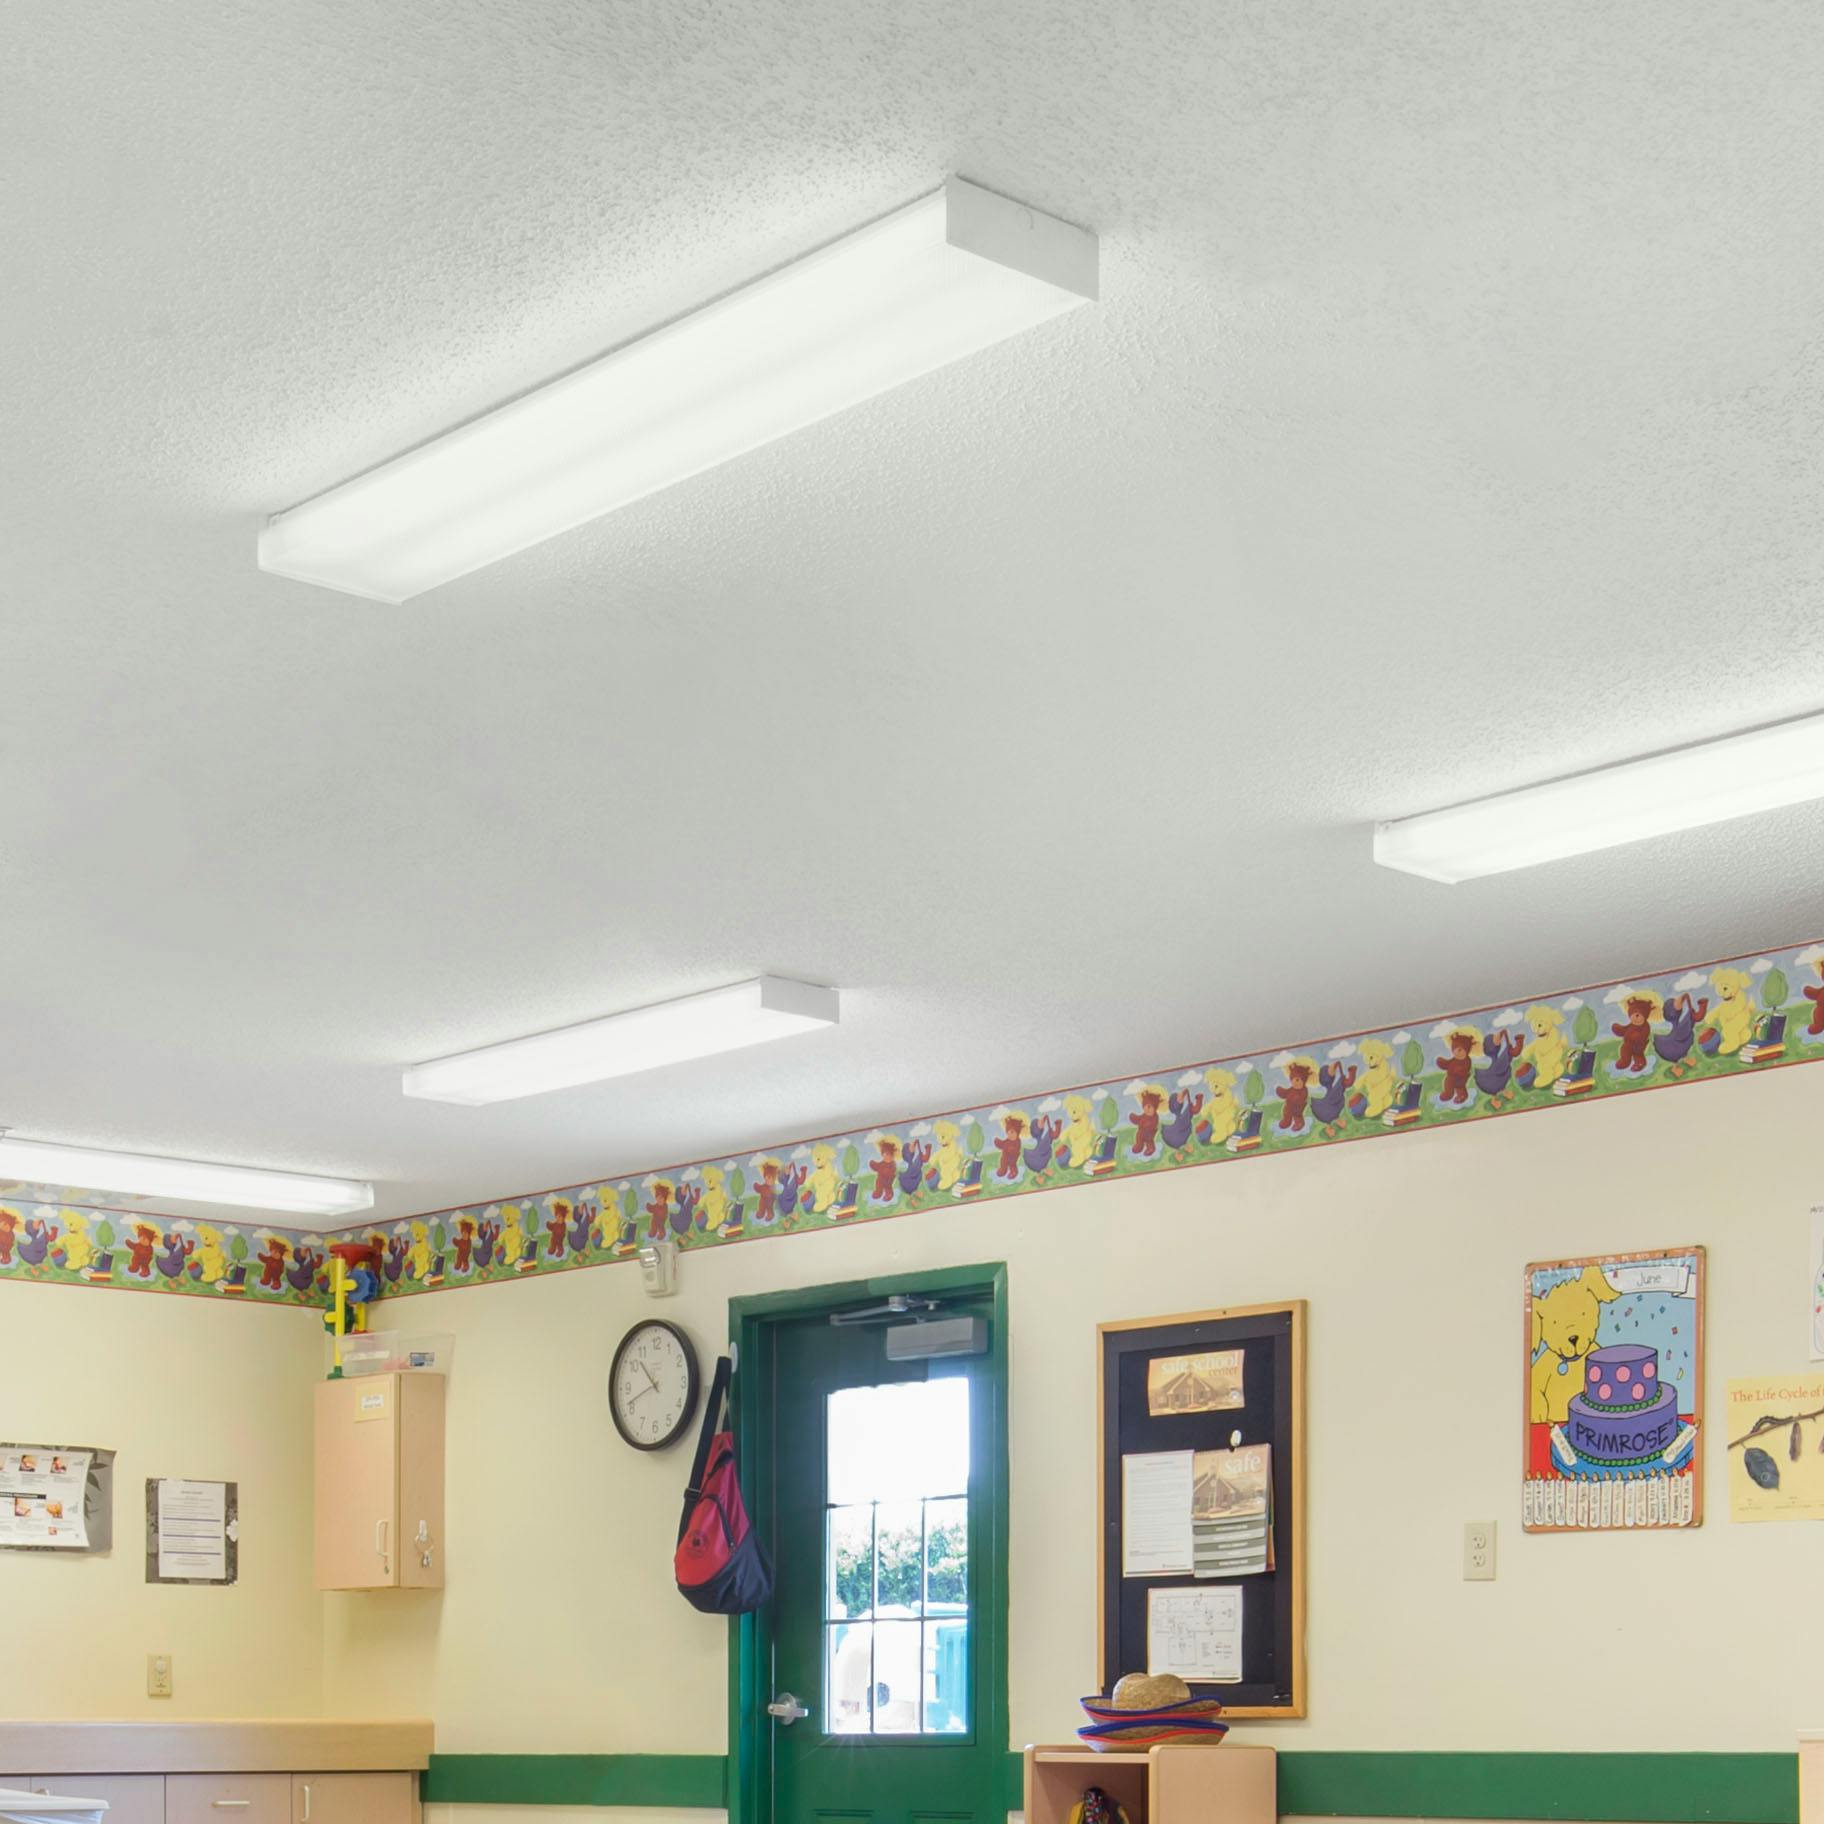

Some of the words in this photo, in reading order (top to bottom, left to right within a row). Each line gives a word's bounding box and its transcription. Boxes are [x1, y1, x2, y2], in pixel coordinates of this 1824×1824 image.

[1636, 1272, 1662, 1287] June
[1161, 1357, 1188, 1373] safe
[1194, 1354, 1237, 1372] school
[1208, 1366, 1238, 1377] center
[1731, 1390, 1753, 1403] The
[1756, 1387, 1776, 1401] Life
[1778, 1387, 1808, 1401] Cycle
[1810, 1385, 1821, 1397] of
[1576, 1421, 1669, 1454] PRIMROSE
[1224, 1451, 1261, 1473] safe
